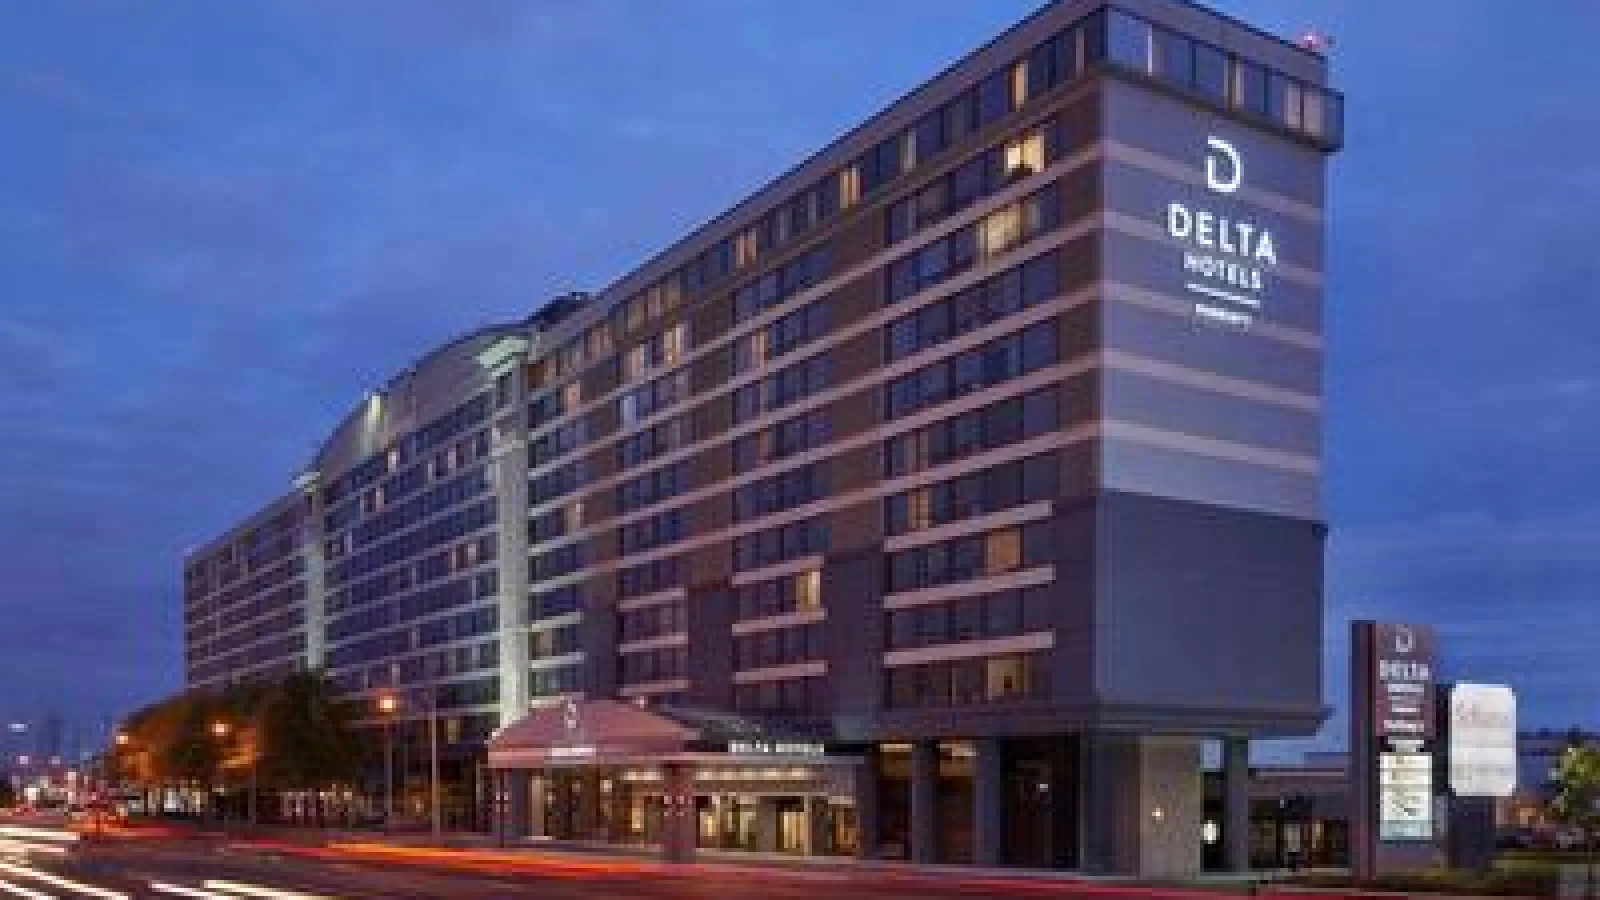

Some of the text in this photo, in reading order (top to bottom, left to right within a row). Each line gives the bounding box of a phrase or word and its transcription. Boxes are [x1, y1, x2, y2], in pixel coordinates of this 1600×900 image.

[1207, 136, 1243, 192] D
[1168, 204, 1276, 265] DELTA
[1184, 253, 1263, 290] HOTELS
